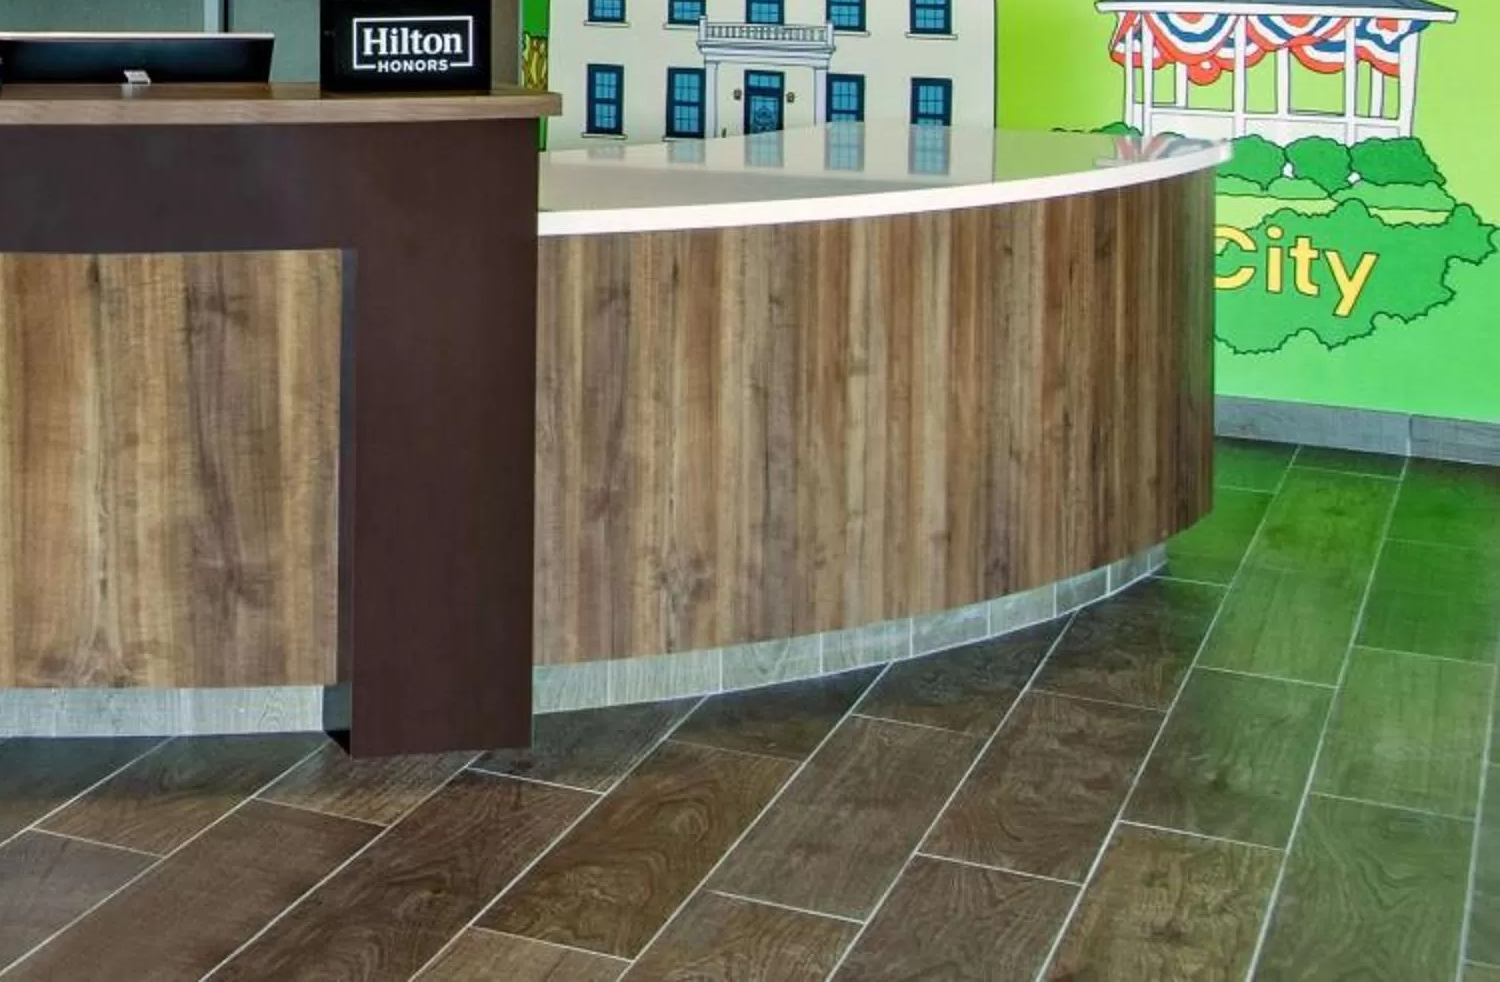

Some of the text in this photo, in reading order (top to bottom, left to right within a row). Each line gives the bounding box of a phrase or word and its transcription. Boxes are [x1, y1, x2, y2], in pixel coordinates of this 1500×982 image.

[362, 26, 463, 56] Hilton
[377, 59, 449, 73] HONORS
[1214, 224, 1380, 318] City
